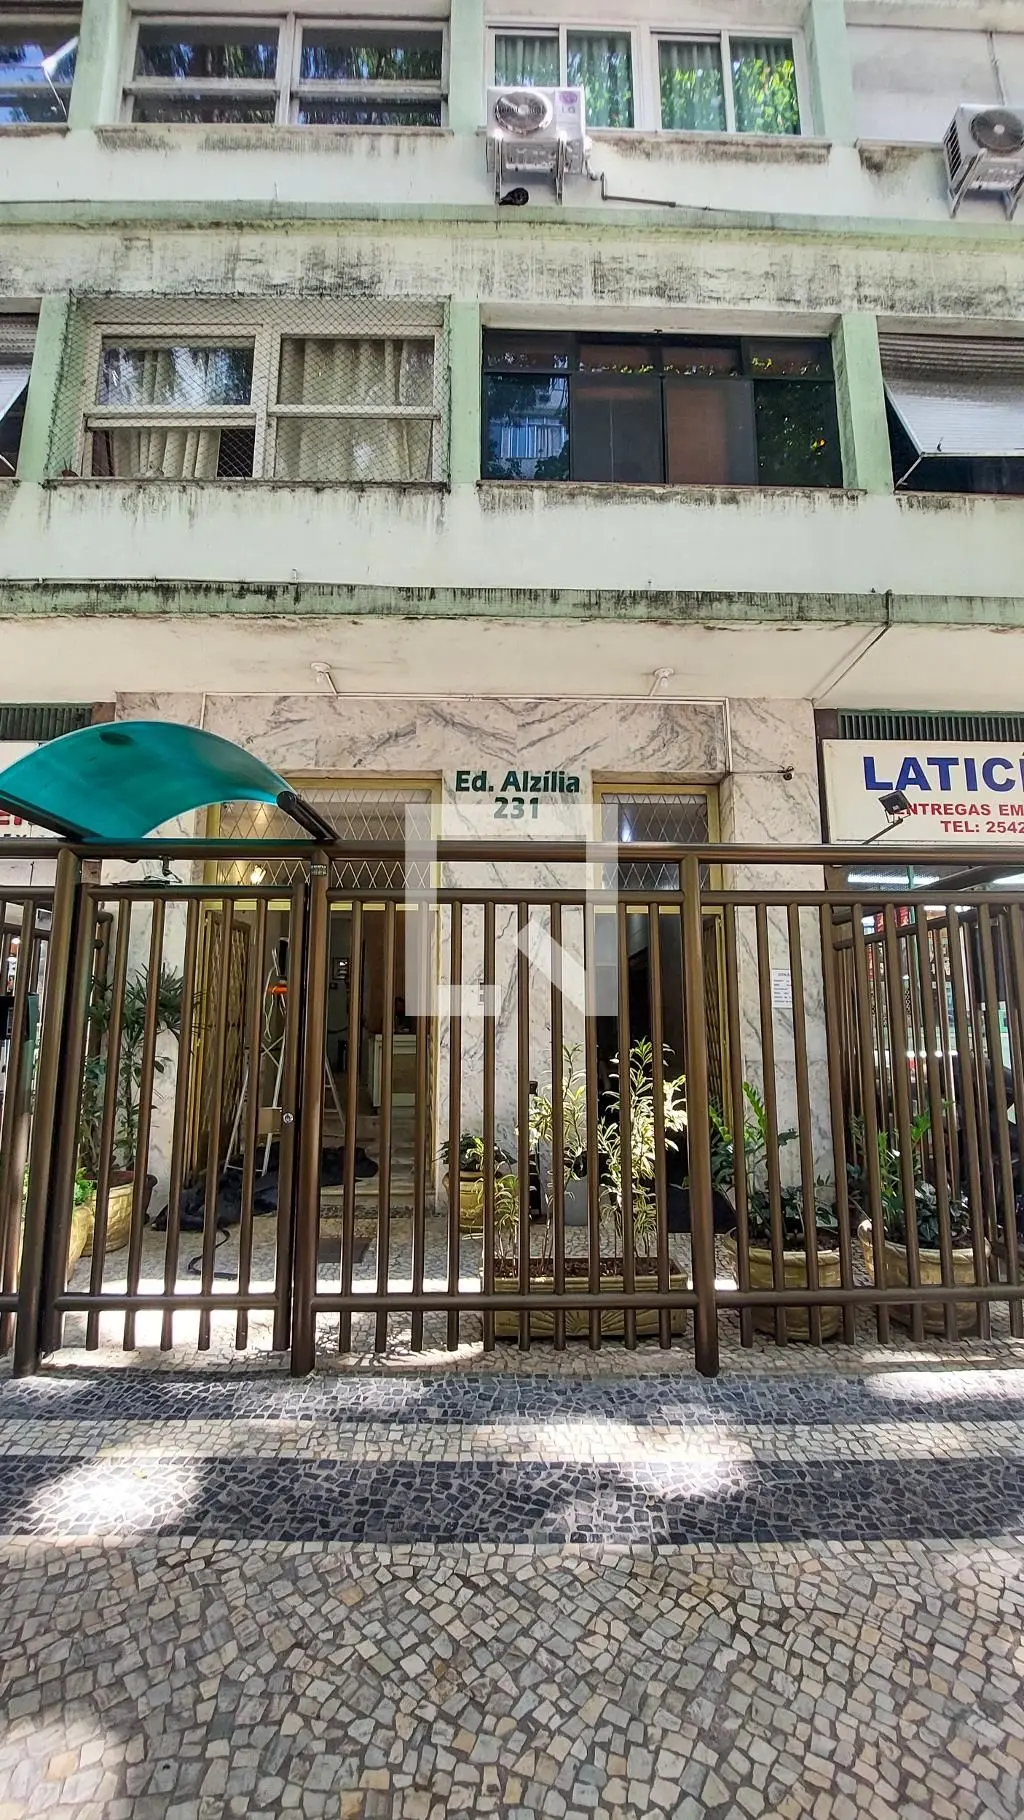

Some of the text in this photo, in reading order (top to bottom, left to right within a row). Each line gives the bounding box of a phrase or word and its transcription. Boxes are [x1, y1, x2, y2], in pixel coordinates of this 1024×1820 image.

[455, 770, 580, 793] Ed. Alzília
[493, 796, 539, 819] 231
[893, 803, 991, 816] NTREGAS
[940, 820, 980, 833] TEL:
